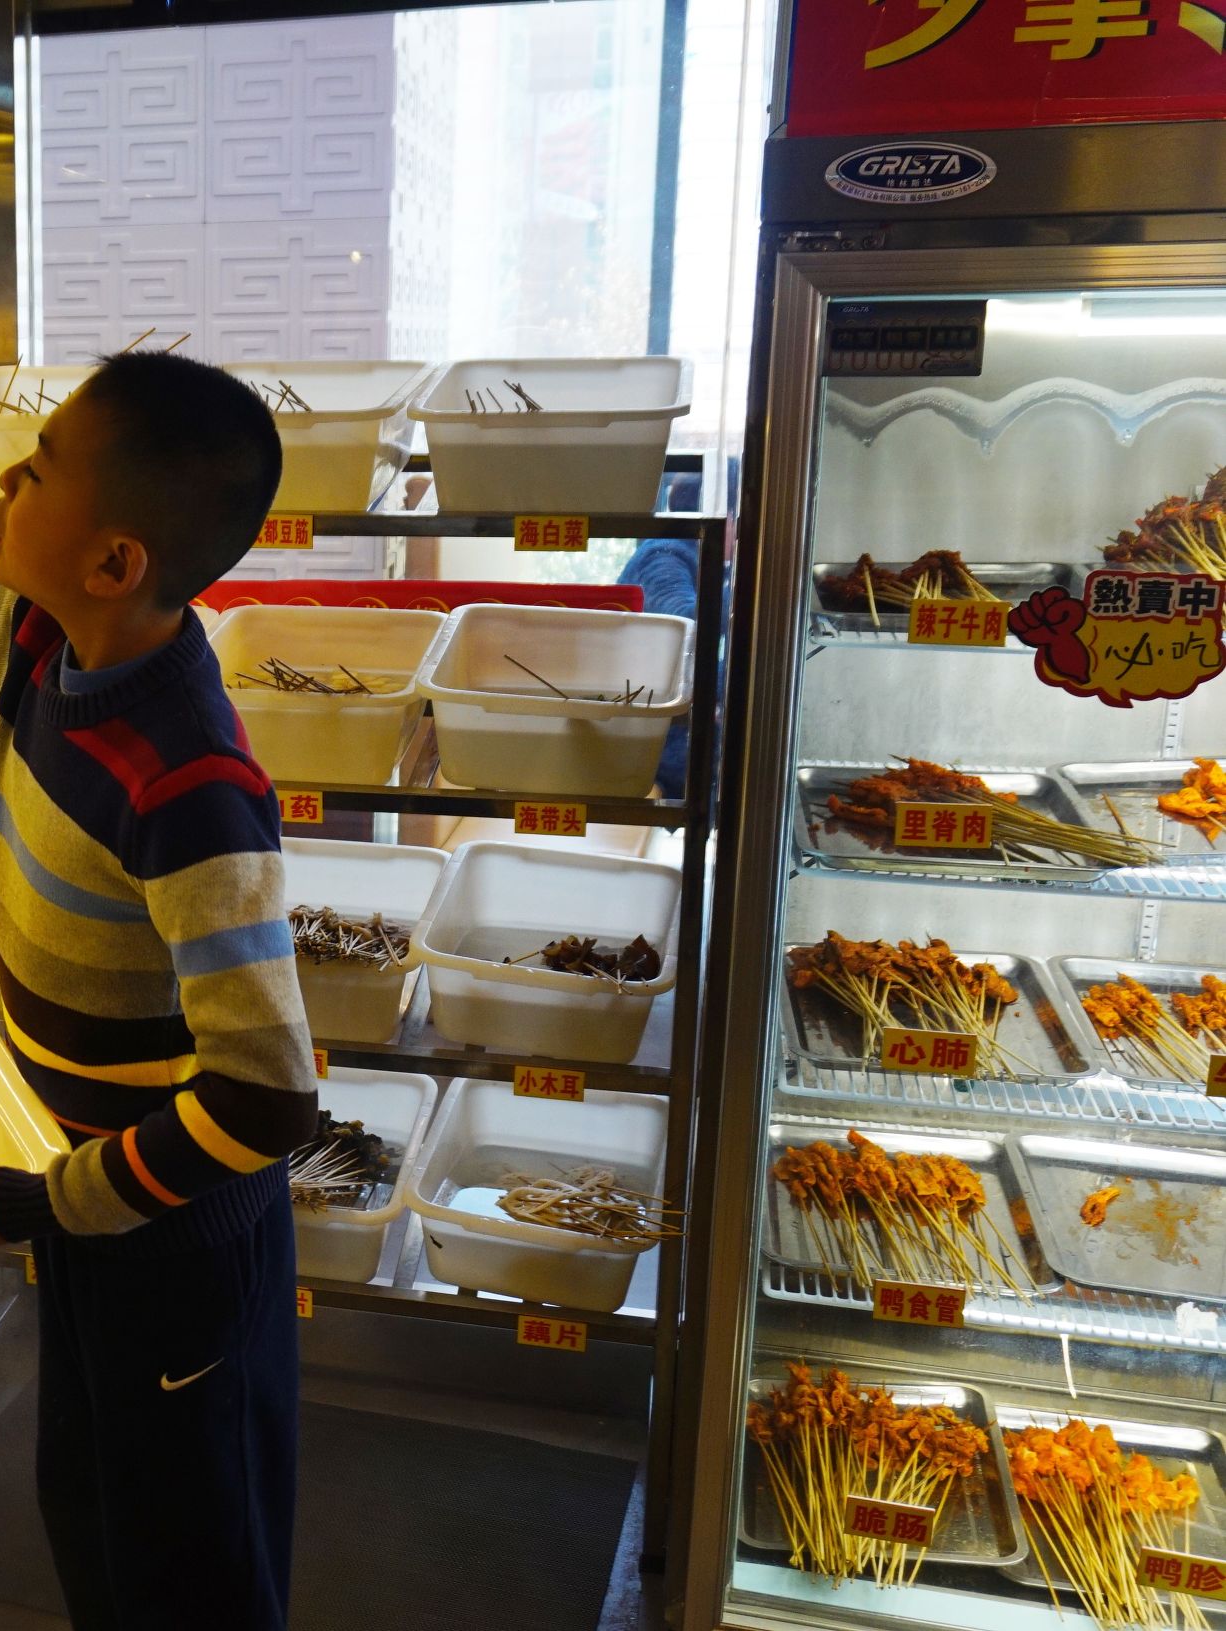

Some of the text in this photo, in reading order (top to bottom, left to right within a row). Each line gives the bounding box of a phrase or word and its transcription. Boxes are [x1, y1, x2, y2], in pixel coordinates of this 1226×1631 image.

[858, 154, 962, 176] GRISTA
[258, 518, 309, 544] 都豆筋
[519, 519, 583, 547] 海白菜
[1092, 577, 1216, 617] 熱賣中
[915, 603, 1003, 641] 辣子牛肉
[519, 806, 582, 832] 海带头
[901, 809, 986, 843] 里脊肉
[888, 1035, 971, 1070] 心肺
[518, 1070, 580, 1098] 小木耳
[880, 1287, 960, 1324] 鸭食管
[522, 1320, 583, 1347] 藕片
[852, 1505, 928, 1542] 脆肠
[1145, 1556, 1226, 1592] 鸭胗
